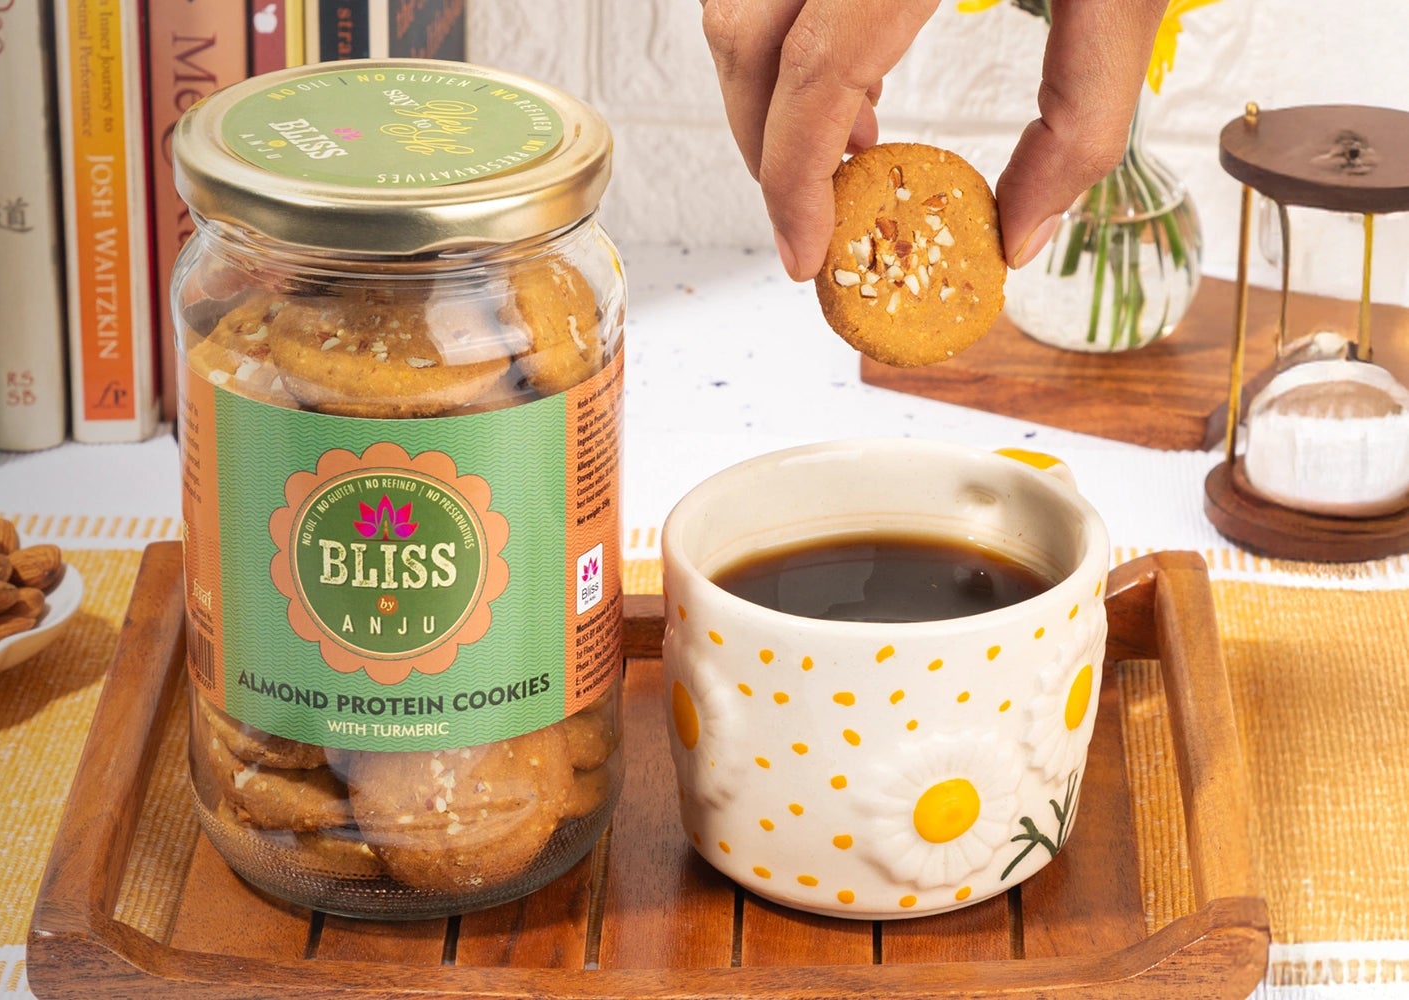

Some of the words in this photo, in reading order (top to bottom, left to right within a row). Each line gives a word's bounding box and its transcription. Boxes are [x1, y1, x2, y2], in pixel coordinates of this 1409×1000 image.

[337, 8, 353, 60] stra
[98, 55, 115, 112] Journey
[297, 79, 331, 91] OIL
[356, 73, 386, 82] NO
[396, 73, 471, 88] GLUTEN
[79, 46, 94, 137] Performance
[267, 88, 296, 100] NO
[490, 88, 519, 100] NO
[413, 118, 432, 129] to
[514, 99, 552, 131] REFINED
[103, 116, 115, 133] to
[268, 118, 349, 159] BLISS
[521, 139, 547, 152] NO
[376, 151, 530, 183] PRESERVATIVES
[87, 154, 115, 218] JOSH
[94, 227, 120, 360] WAITZKIN
[365, 479, 379, 489] NO
[382, 478, 417, 492] REFINED
[328, 483, 356, 504] GLUTEN
[426, 489, 440, 502] NO
[316, 501, 330, 515] NO
[306, 519, 318, 533] OIL
[439, 498, 476, 550] PRESERVATIVES
[302, 532, 312, 546] NO
[318, 539, 458, 590] BLISS
[582, 582, 599, 601] Bliss
[380, 598, 395, 612] by
[238, 669, 329, 709] ALMOND
[337, 694, 444, 716] PROTEIN
[452, 673, 550, 712] COOKIES
[327, 719, 367, 736] WITH
[371, 722, 450, 737] TURMERIC
